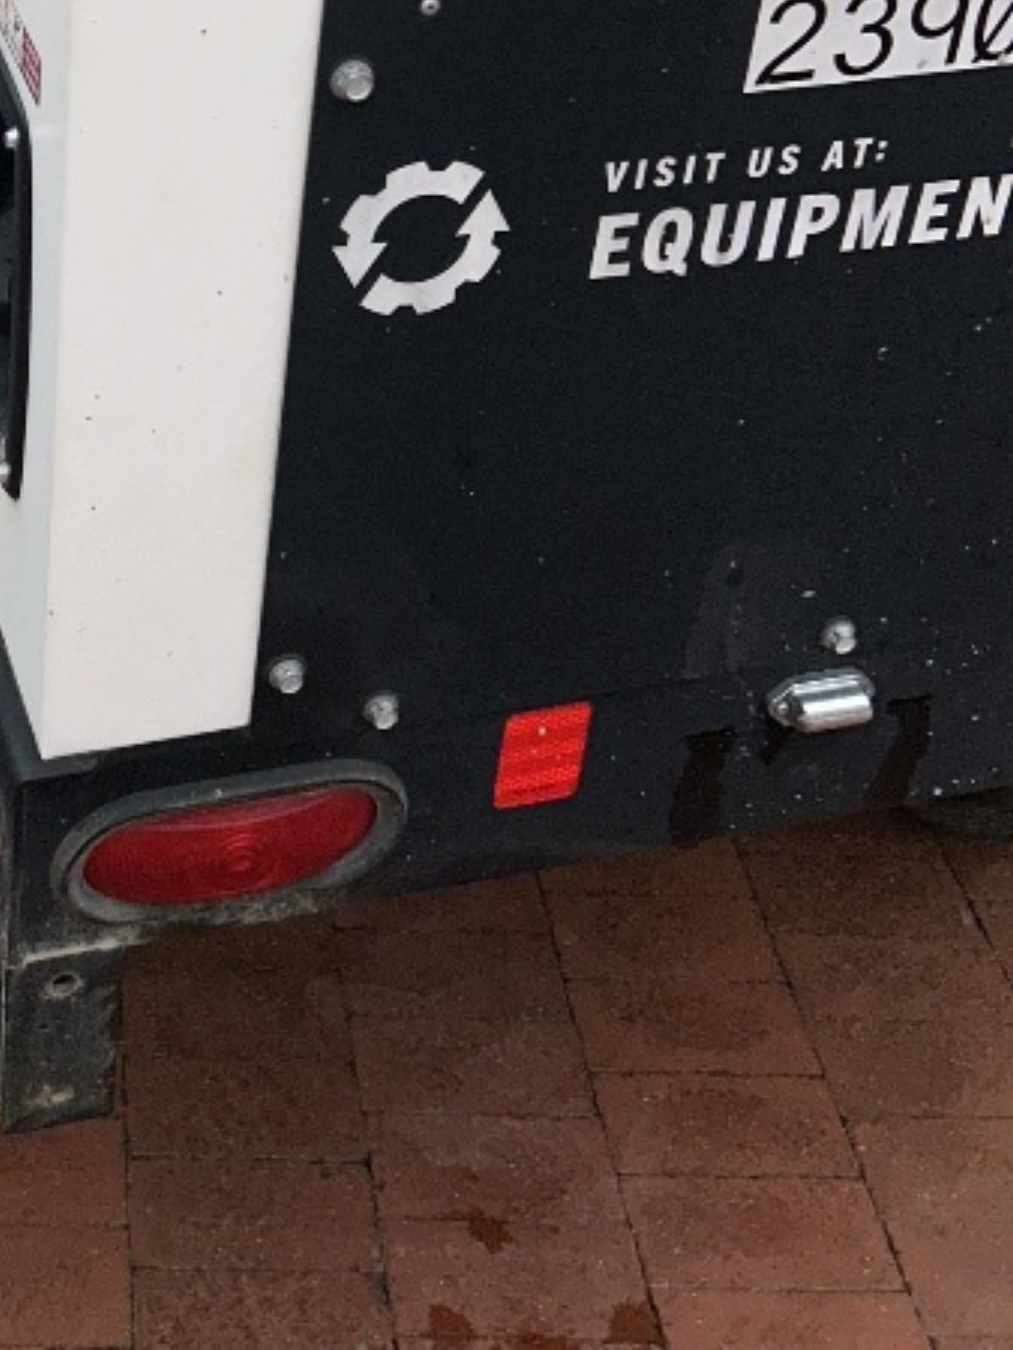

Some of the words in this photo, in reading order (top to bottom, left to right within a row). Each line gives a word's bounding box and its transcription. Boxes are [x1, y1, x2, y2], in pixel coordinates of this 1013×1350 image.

[605, 152, 726, 193] VISIT
[747, 144, 801, 179] US
[821, 137, 888, 172] AT:
[589, 174, 1013, 280] EQUIPMEN
